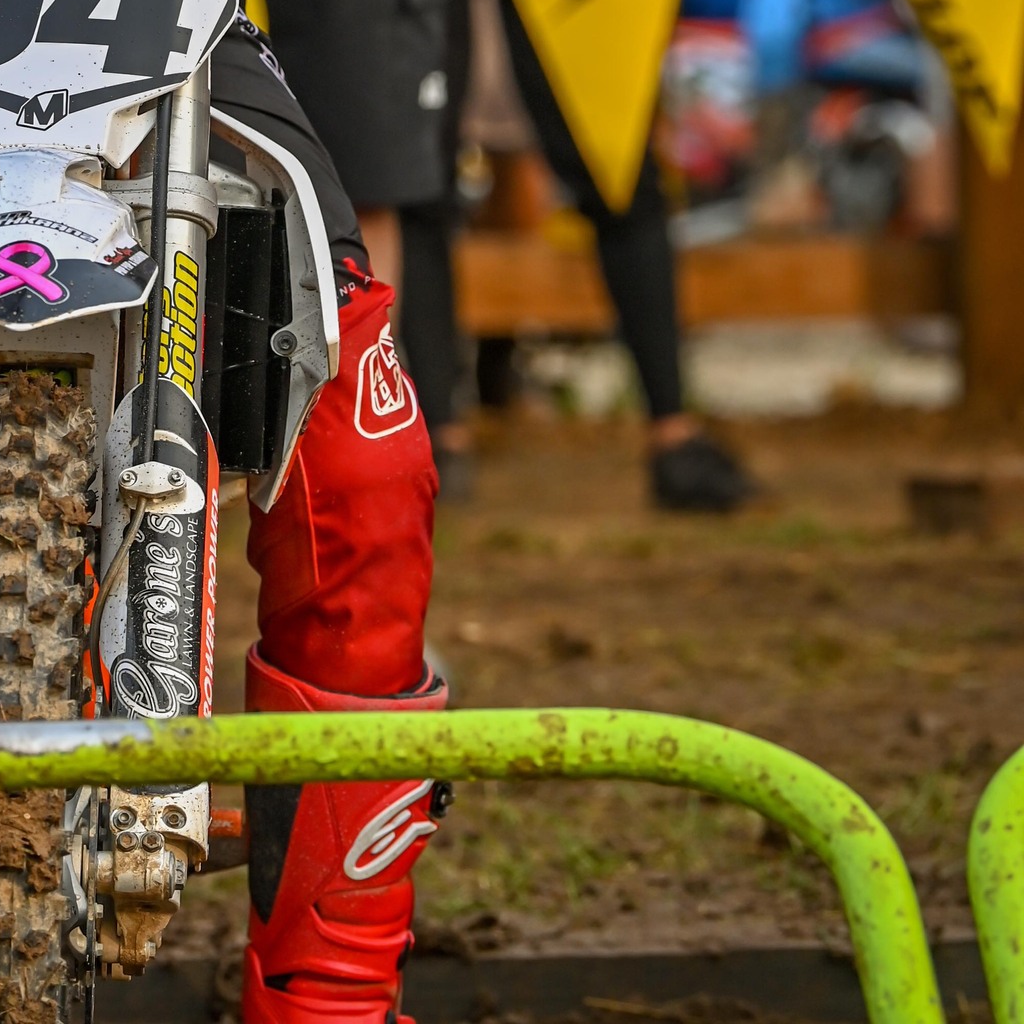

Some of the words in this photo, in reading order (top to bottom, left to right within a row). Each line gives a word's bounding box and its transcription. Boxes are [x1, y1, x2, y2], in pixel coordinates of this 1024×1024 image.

[184, 517, 199, 602] LANDSCAPE
[184, 607, 195, 617] &
[182, 621, 193, 668] LAWN
